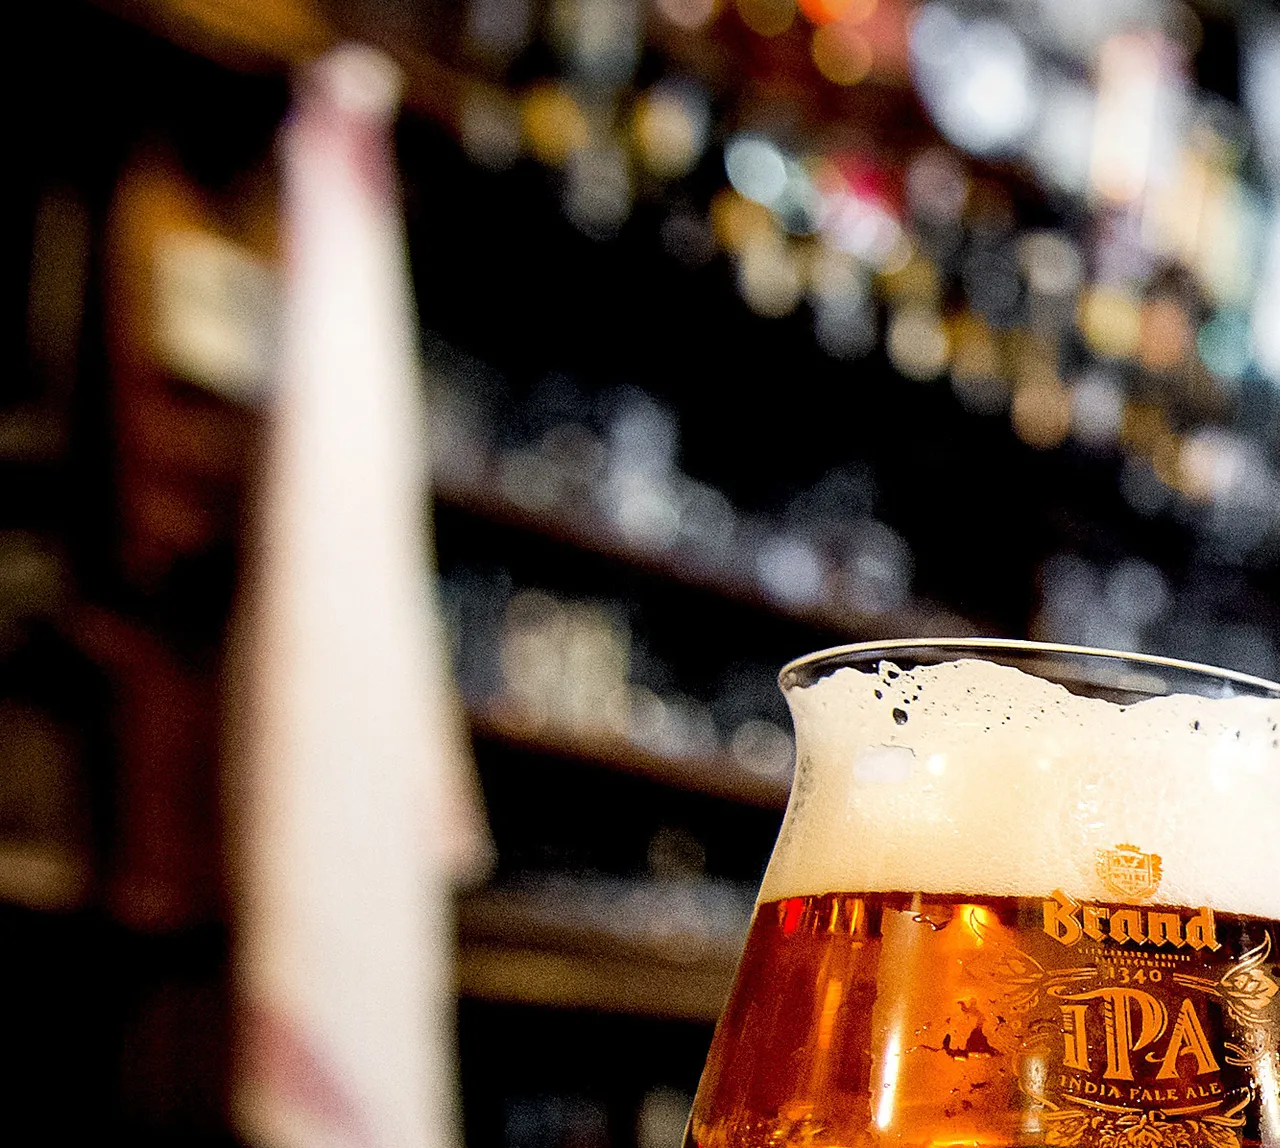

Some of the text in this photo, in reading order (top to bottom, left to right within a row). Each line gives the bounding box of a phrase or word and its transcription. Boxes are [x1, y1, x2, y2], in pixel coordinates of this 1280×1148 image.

[1042, 888, 1222, 952] Brand
[1108, 967, 1162, 984] 1340
[1047, 987, 1221, 1081] IPA
[1058, 1074, 1221, 1101] INDIA PALE ALE
